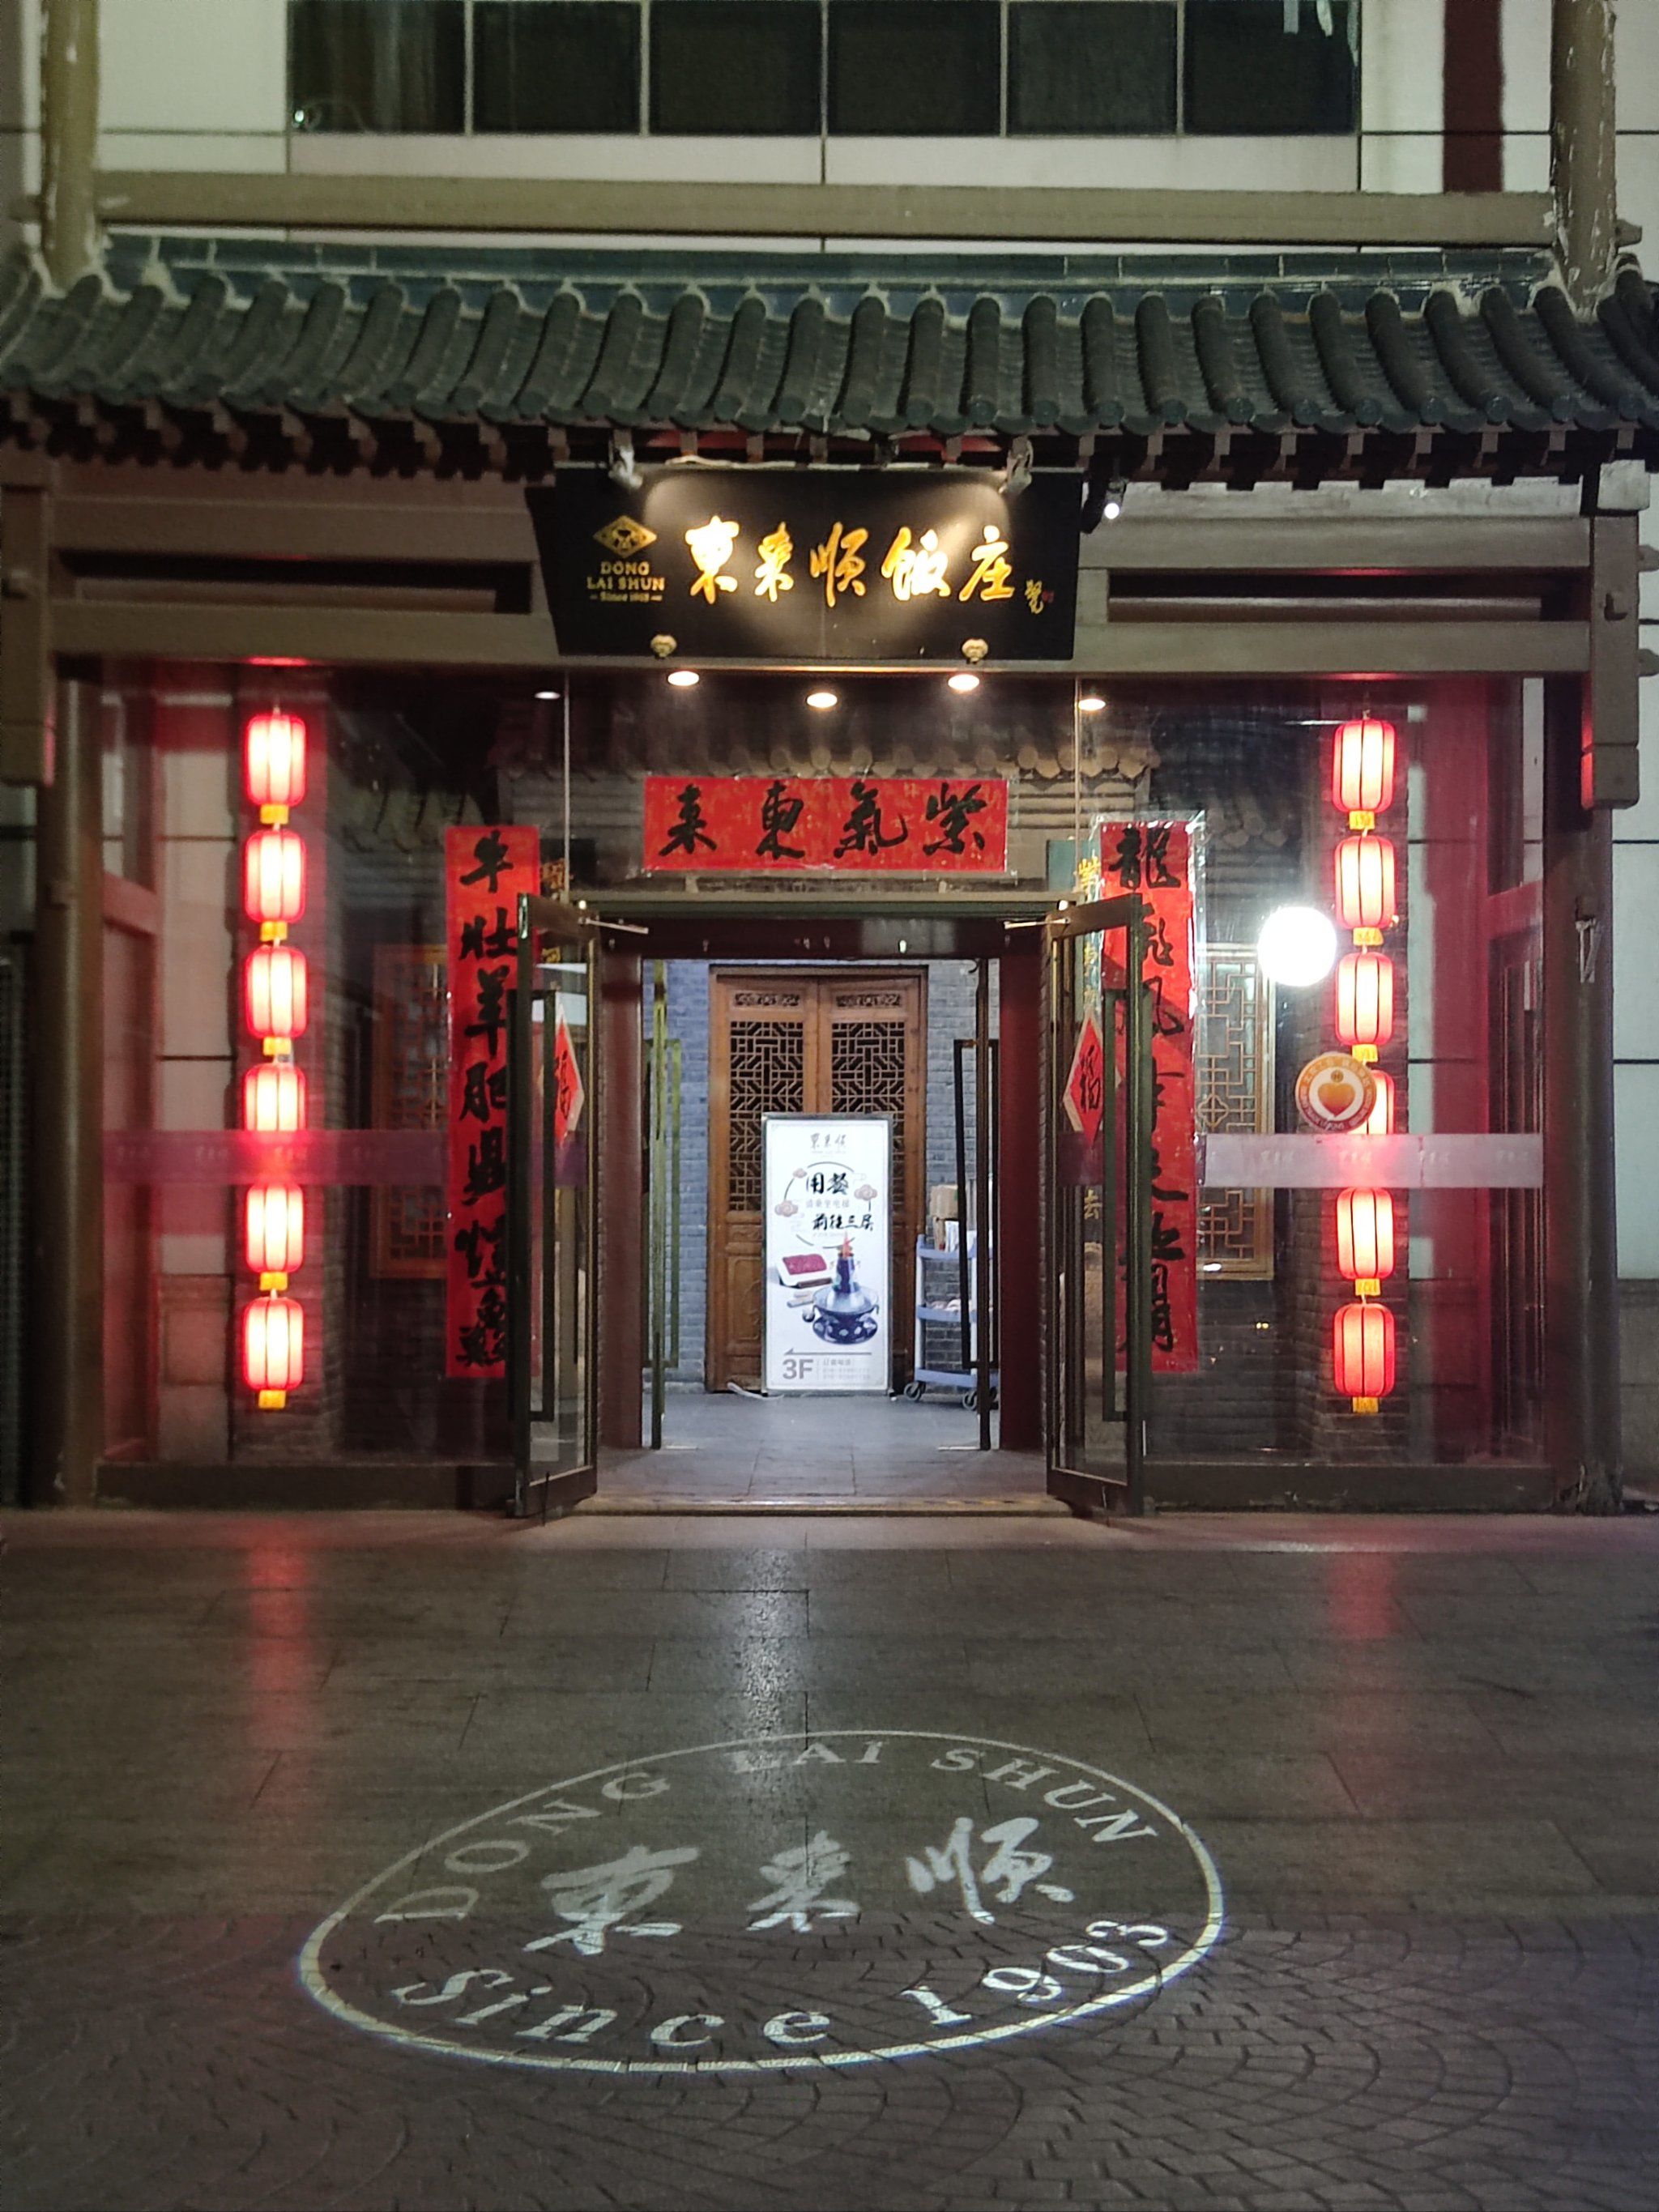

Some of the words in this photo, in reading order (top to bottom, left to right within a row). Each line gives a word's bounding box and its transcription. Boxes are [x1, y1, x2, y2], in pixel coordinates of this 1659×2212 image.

[600, 560, 650, 576] DONG
[586, 576, 613, 590] LAI
[618, 577, 665, 591] SHUN
[806, 1172, 850, 1195] 用餐
[783, 1358, 814, 1380] 3F
[373, 1772, 671, 1924] DONG
[724, 1740, 888, 1773] LAI
[930, 1746, 1158, 1843] SHUN
[390, 1969, 831, 2047] Since
[900, 1920, 1168, 2027] 1903
